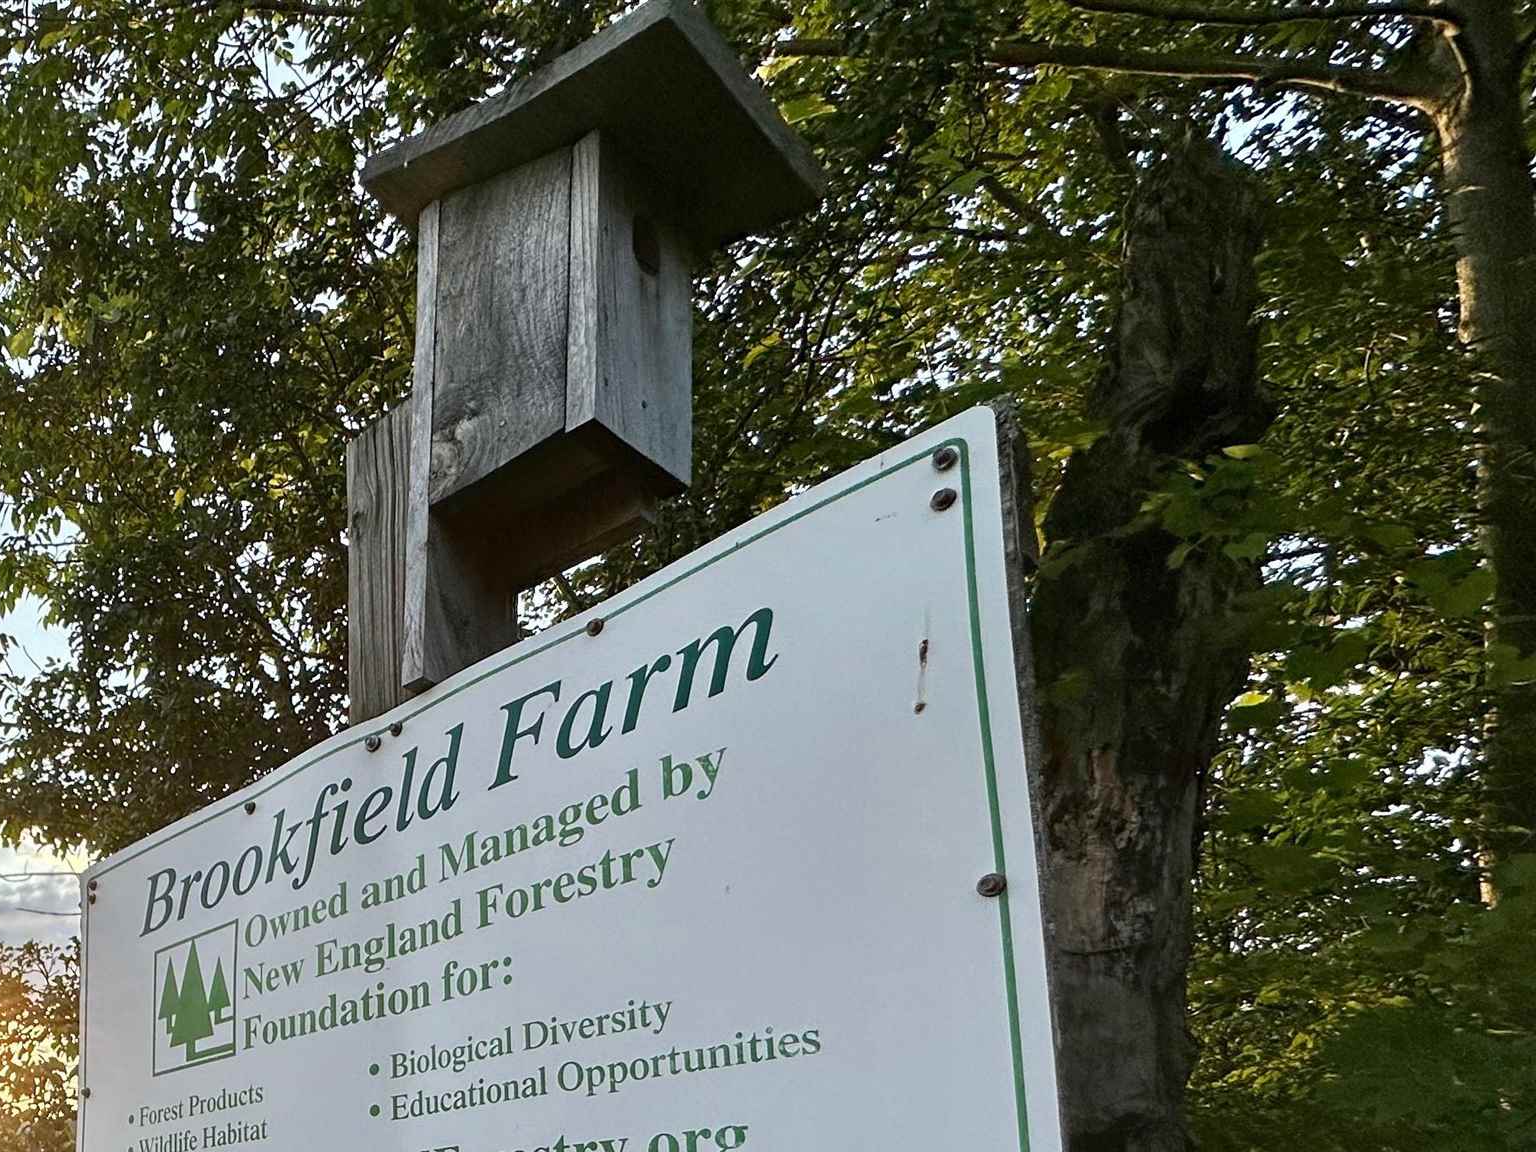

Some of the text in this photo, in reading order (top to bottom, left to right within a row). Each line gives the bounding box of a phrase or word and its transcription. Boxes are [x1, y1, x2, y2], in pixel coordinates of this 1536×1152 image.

[139, 608, 778, 937] Brookfield Farm
[245, 748, 727, 947] Owned and Managed by
[243, 838, 675, 999] New England Forestry
[243, 957, 512, 1050] Foundation for:
[390, 1000, 672, 1079] Biological Diversity
[140, 1085, 263, 1126] Forest Products
[391, 1028, 820, 1120] Educational Opportunities
[203, 1120, 267, 1148] Habitat
